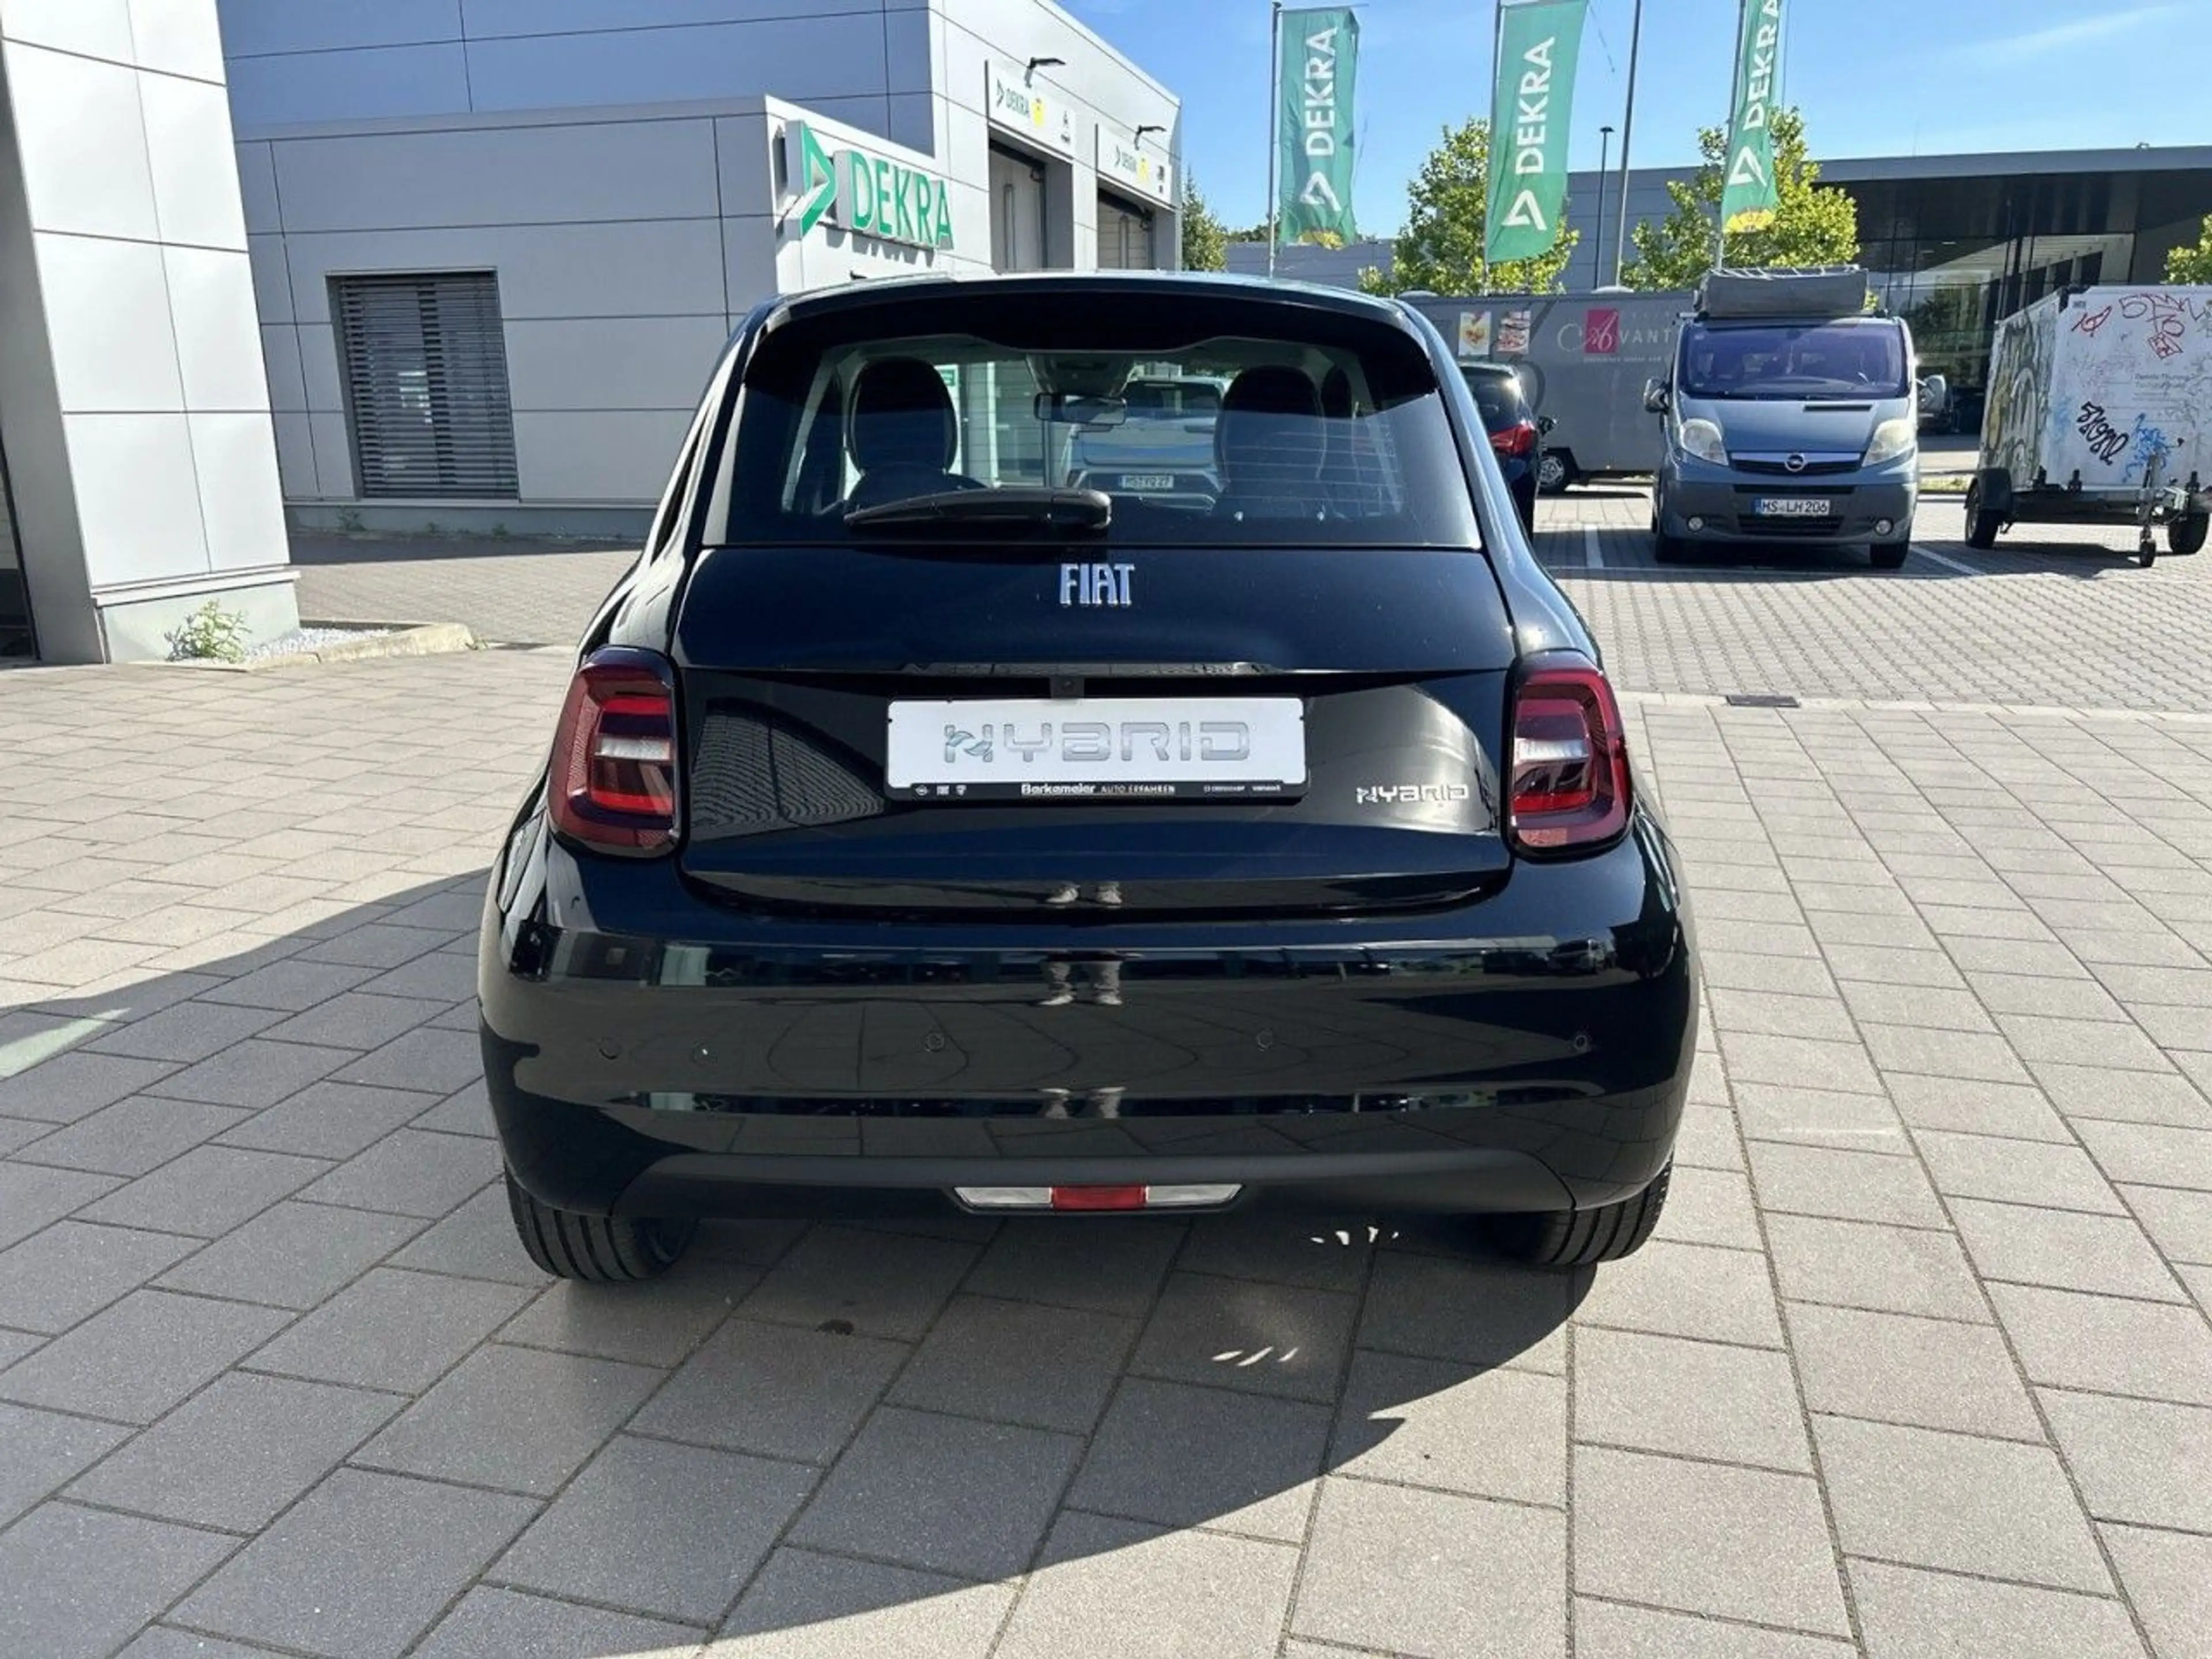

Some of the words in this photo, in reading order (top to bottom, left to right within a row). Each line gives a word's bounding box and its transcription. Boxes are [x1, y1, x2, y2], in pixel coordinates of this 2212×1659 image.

[1304, 26, 1338, 156] DEKRA
[1515, 36, 1555, 175] DEKRA
[849, 150, 955, 250] DEKRA
[1059, 563, 1135, 605] FIAT
[944, 721, 1250, 763] HYBRID
[1356, 783, 1468, 805] HYBRID
